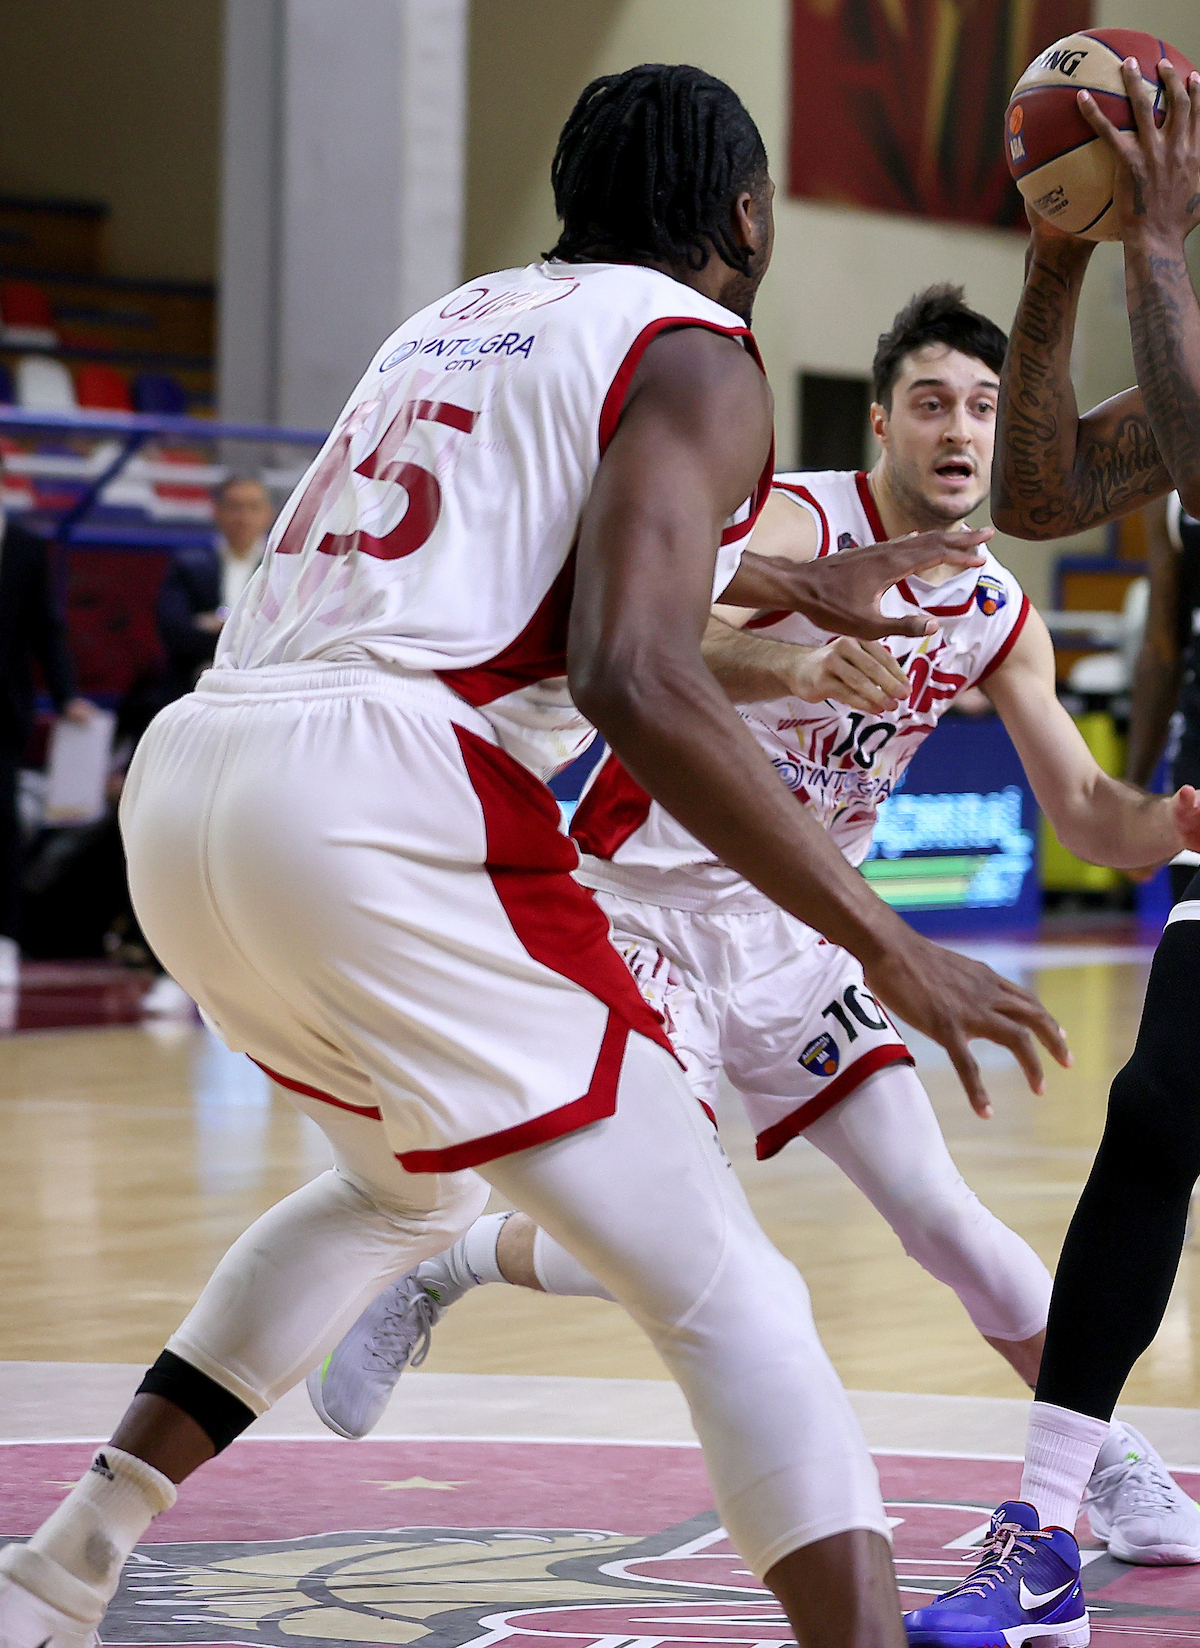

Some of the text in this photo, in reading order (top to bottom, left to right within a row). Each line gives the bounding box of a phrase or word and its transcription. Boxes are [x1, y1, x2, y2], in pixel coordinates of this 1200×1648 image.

[445, 359, 483, 372] CITY
[275, 399, 481, 561] 15
[831, 711, 897, 769] 10
[822, 984, 888, 1042] 10
